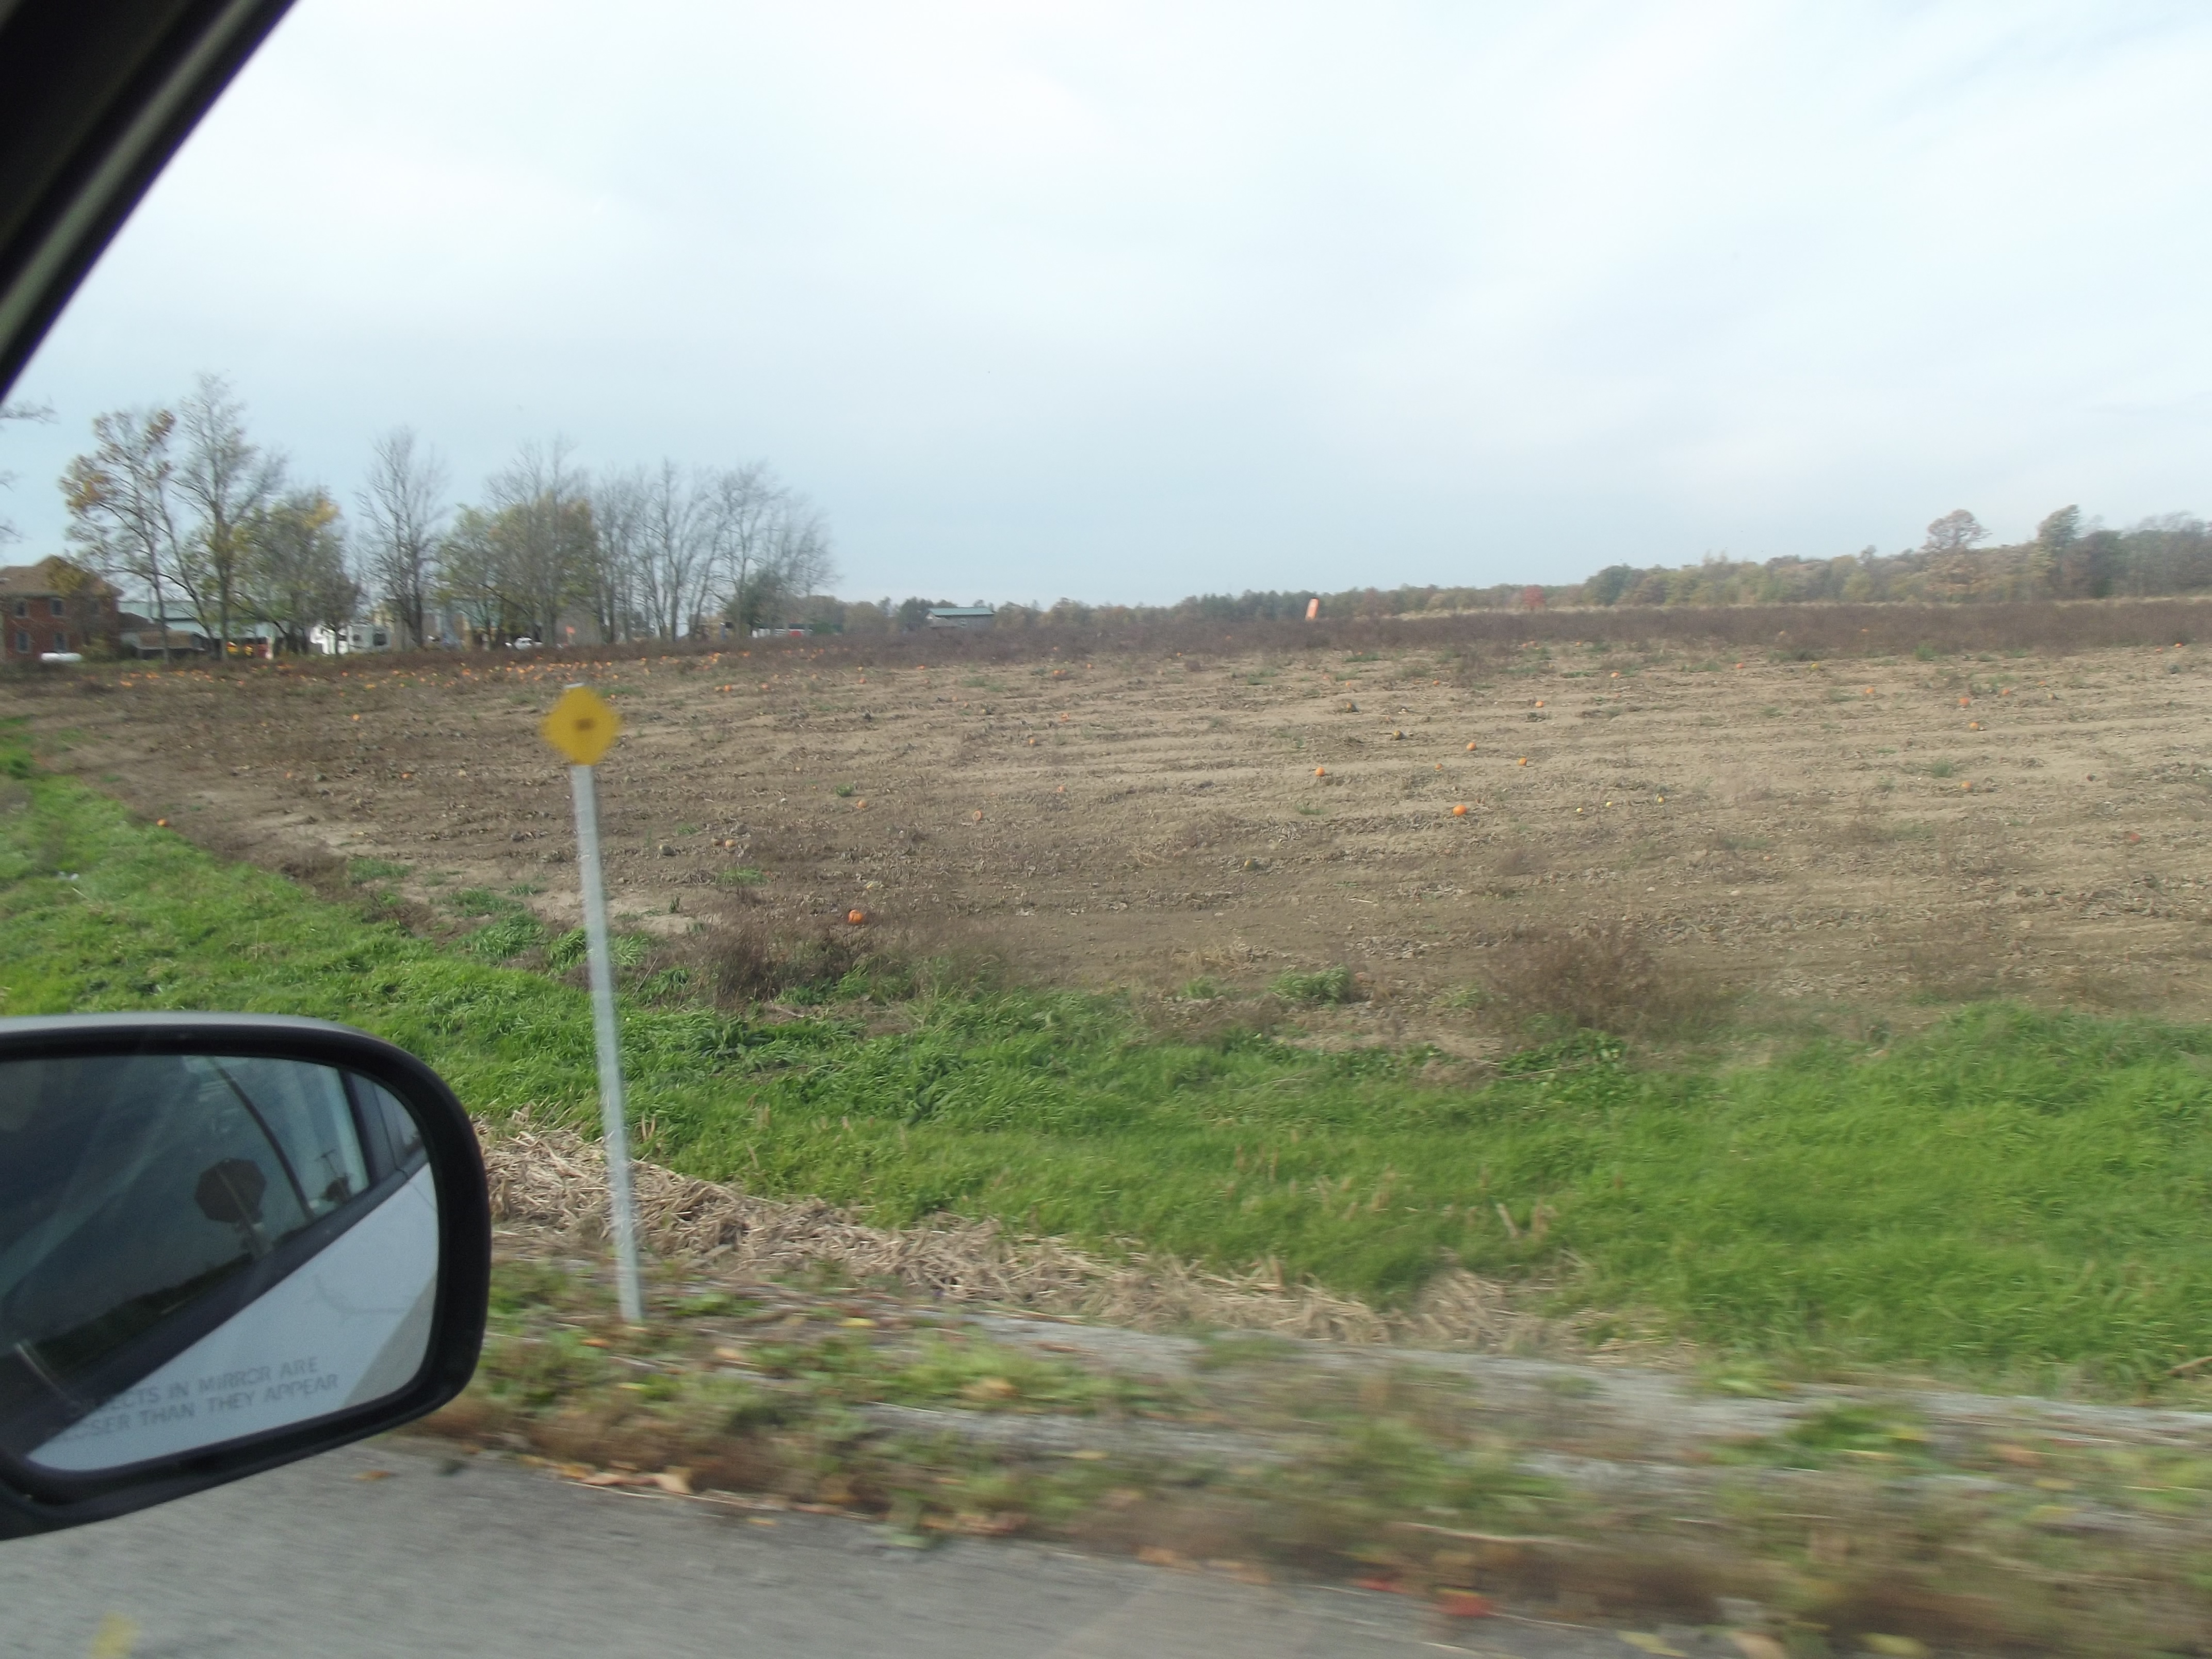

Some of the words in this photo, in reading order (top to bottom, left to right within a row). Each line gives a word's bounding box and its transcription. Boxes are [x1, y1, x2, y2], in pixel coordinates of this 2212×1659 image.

[139, 1401, 195, 1427] THAN
[207, 1390, 255, 1412] THEY
[264, 1373, 339, 1403] APPEAR
[168, 1380, 189, 1399] IN
[198, 1365, 270, 1394] MIRROR
[279, 1355, 318, 1378] ARE
